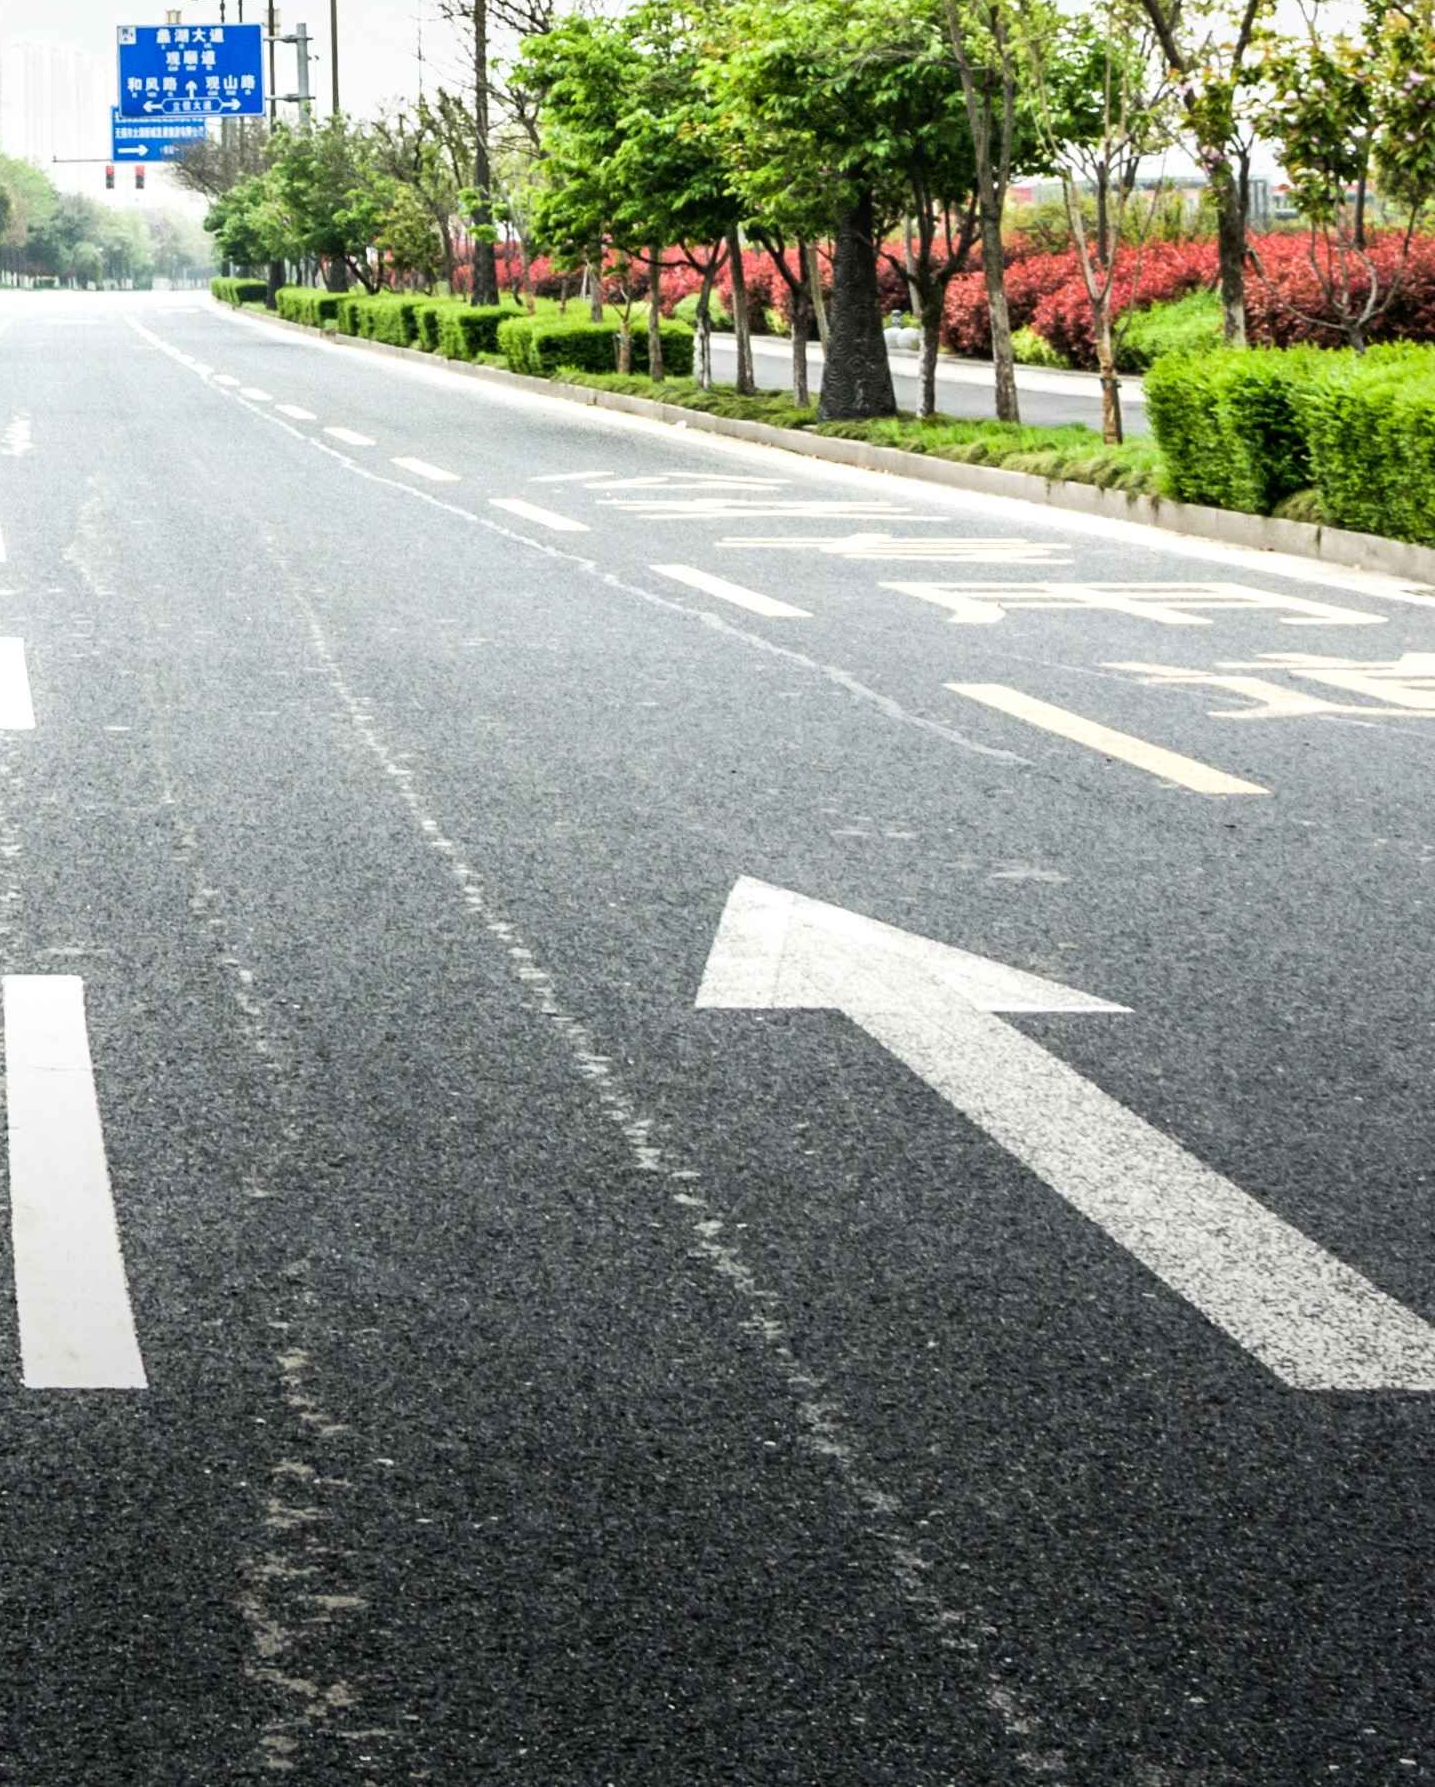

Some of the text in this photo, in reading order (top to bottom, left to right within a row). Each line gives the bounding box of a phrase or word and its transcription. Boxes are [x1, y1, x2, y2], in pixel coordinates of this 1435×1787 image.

[127, 76, 178, 92] 和风路
[205, 74, 256, 91] 观山路
